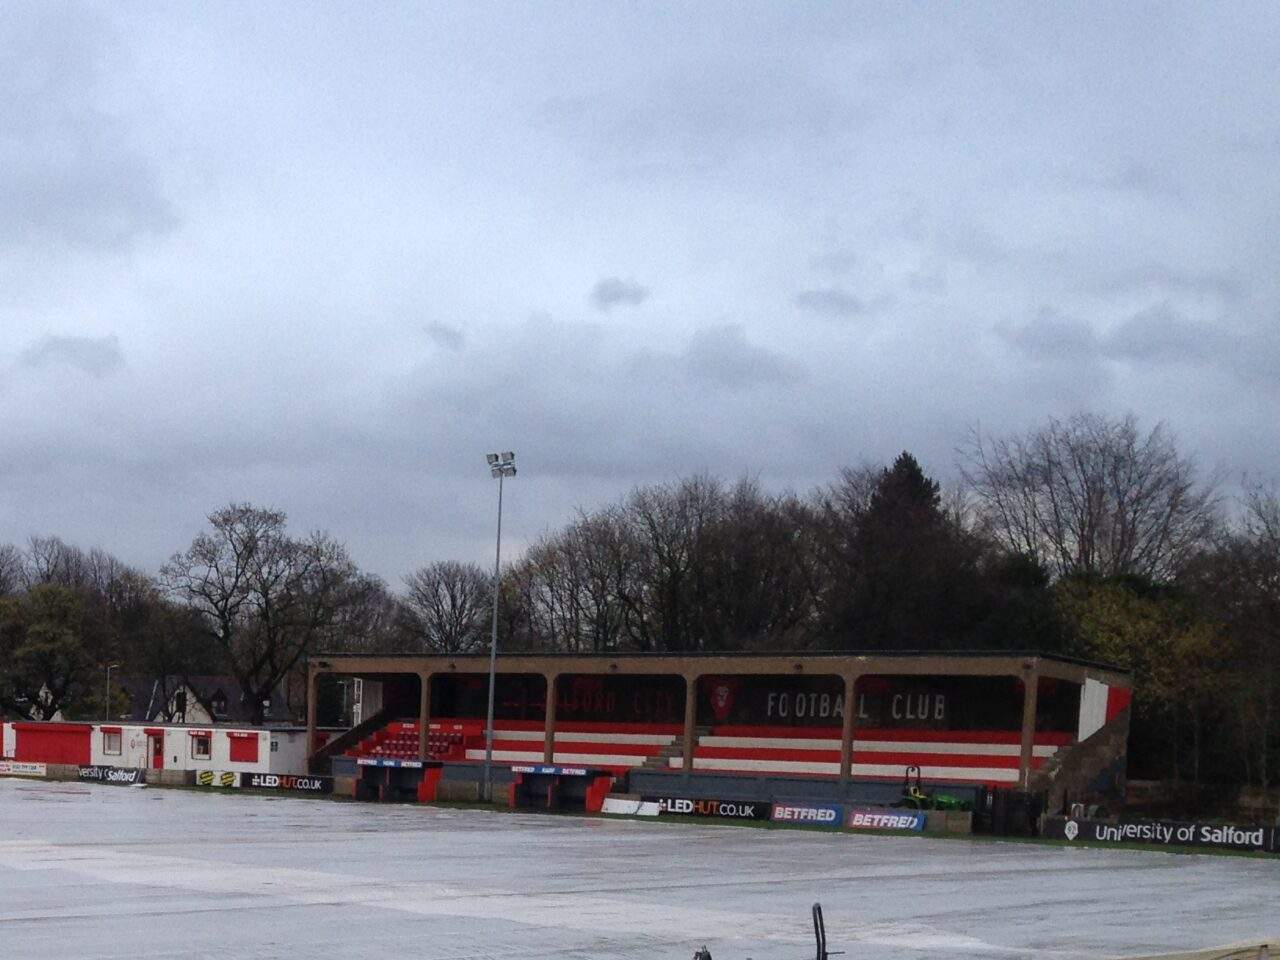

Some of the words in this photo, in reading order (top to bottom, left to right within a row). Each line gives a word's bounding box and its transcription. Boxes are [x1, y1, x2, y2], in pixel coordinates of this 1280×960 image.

[767, 692, 869, 719] FOOTBAL
[891, 693, 946, 720] CLUB
[106, 769, 137, 782] Salford
[667, 798, 755, 817] LEDHUT.CO.UK
[773, 805, 837, 823] BETFRED
[851, 812, 919, 831] BETFRED
[1176, 824, 1196, 842] of
[1200, 825, 1264, 847] Salford
